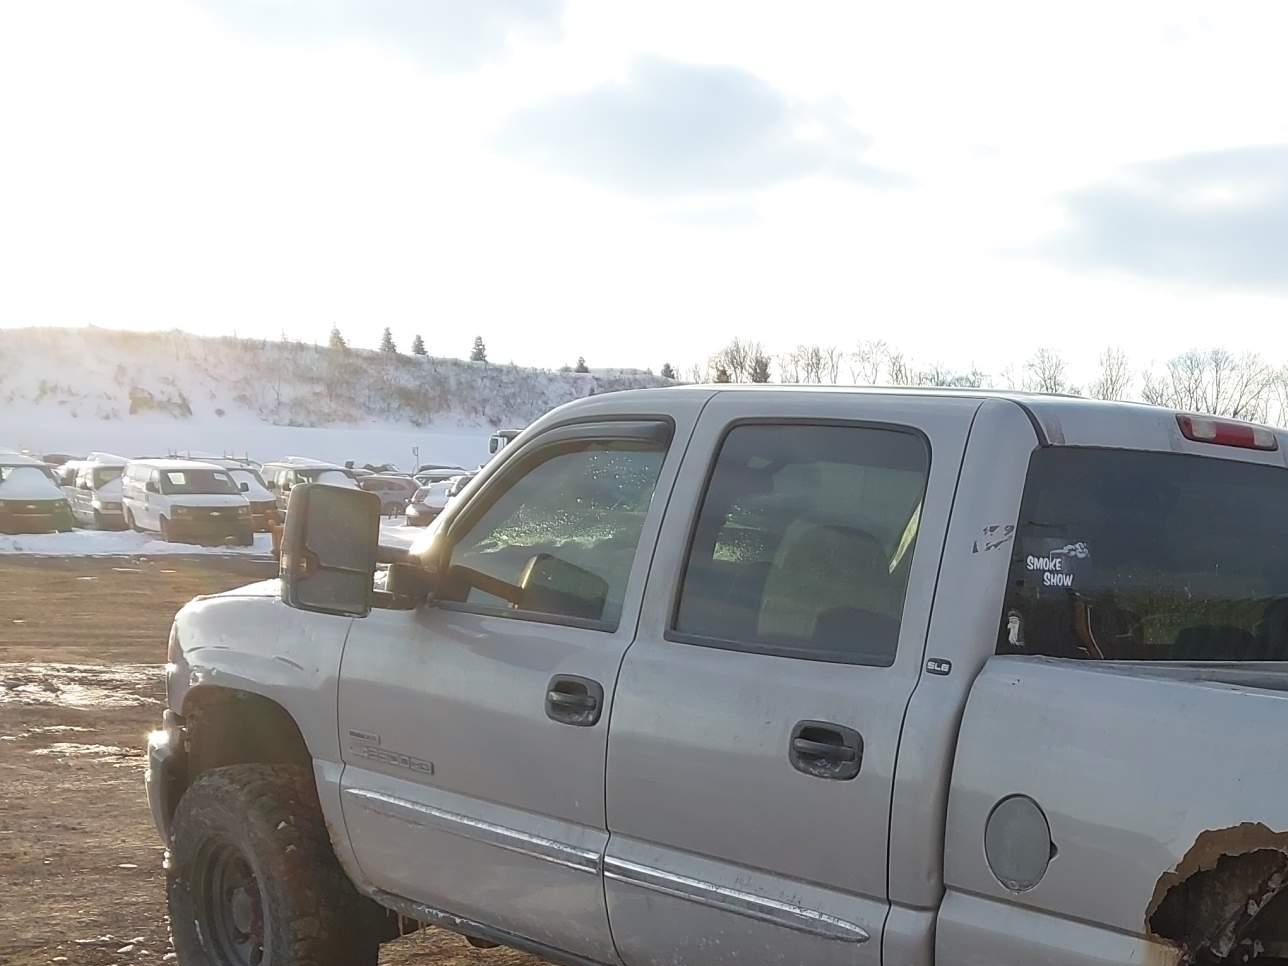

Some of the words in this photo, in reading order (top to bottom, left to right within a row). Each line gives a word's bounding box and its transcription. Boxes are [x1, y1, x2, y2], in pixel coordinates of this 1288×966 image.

[1026, 555, 1062, 571] SMOKE
[1043, 571, 1073, 587] SHOW
[927, 661, 950, 672] SLE
